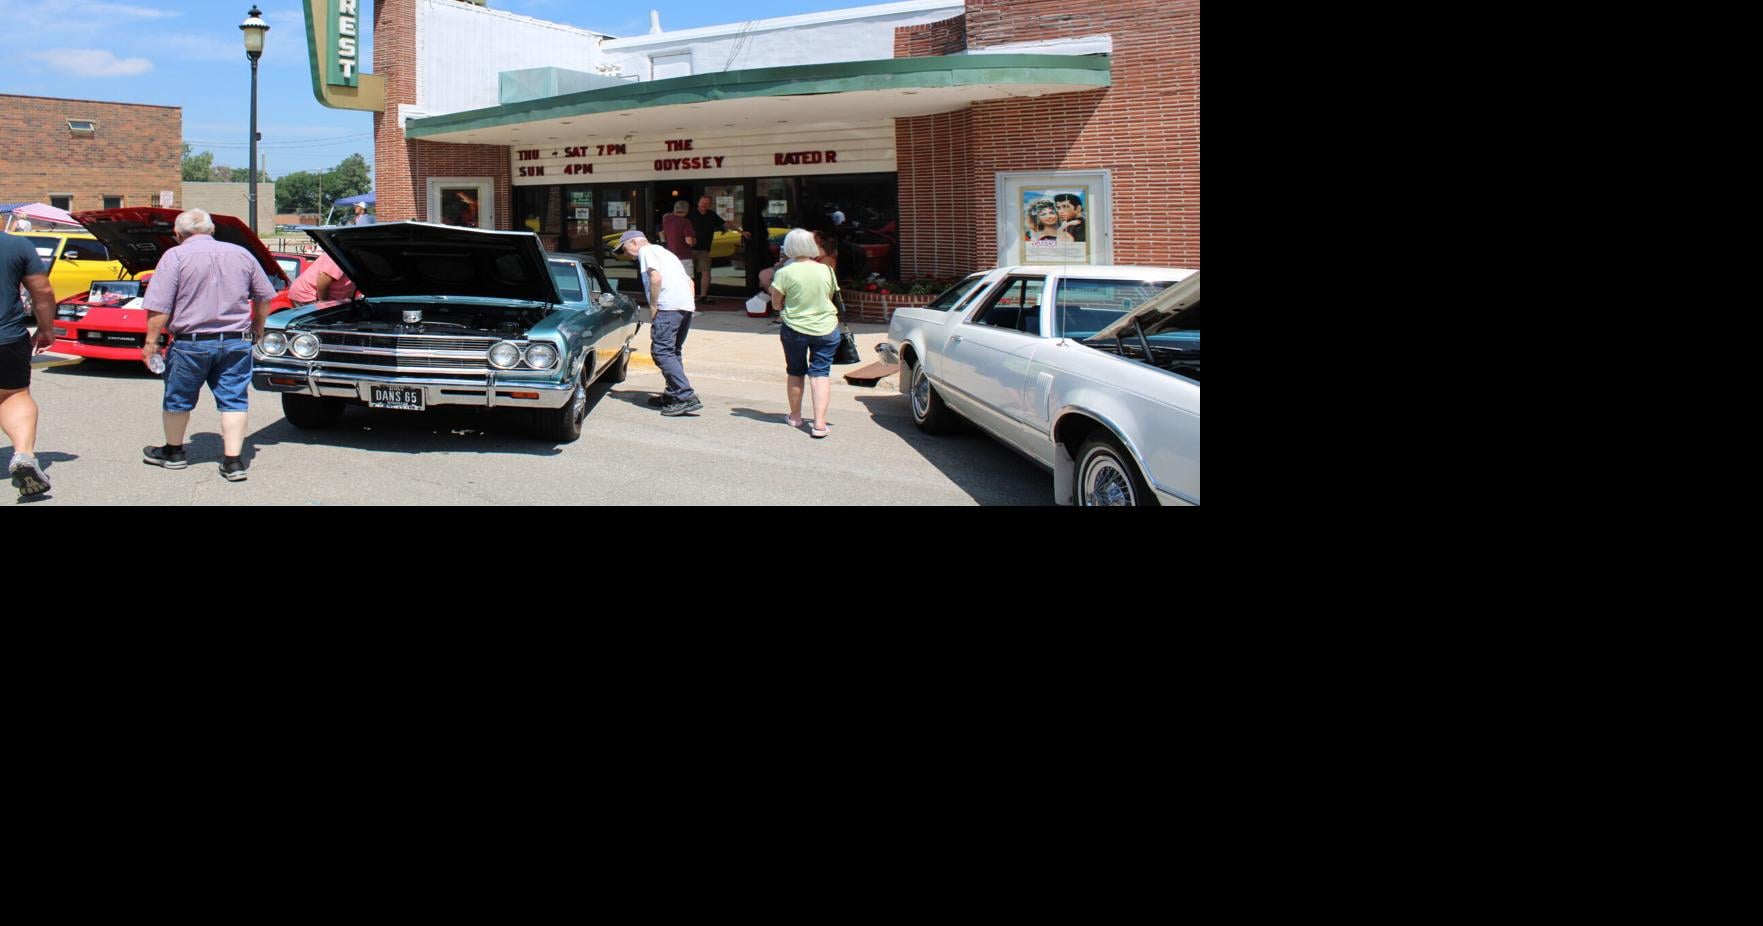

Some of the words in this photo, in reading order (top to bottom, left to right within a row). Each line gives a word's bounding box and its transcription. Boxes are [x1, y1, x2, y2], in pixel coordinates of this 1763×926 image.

[338, 0, 356, 78] REST
[664, 139, 694, 152] THE
[517, 149, 540, 161] THU
[564, 146, 589, 158] SAT
[774, 151, 822, 166] RATED
[825, 150, 838, 163] R
[518, 166, 545, 177] SUN
[563, 163, 593, 175] 4PM
[653, 156, 725, 171] ODYSSEY
[375, 389, 401, 402] DANS
[404, 391, 417, 403] 65
